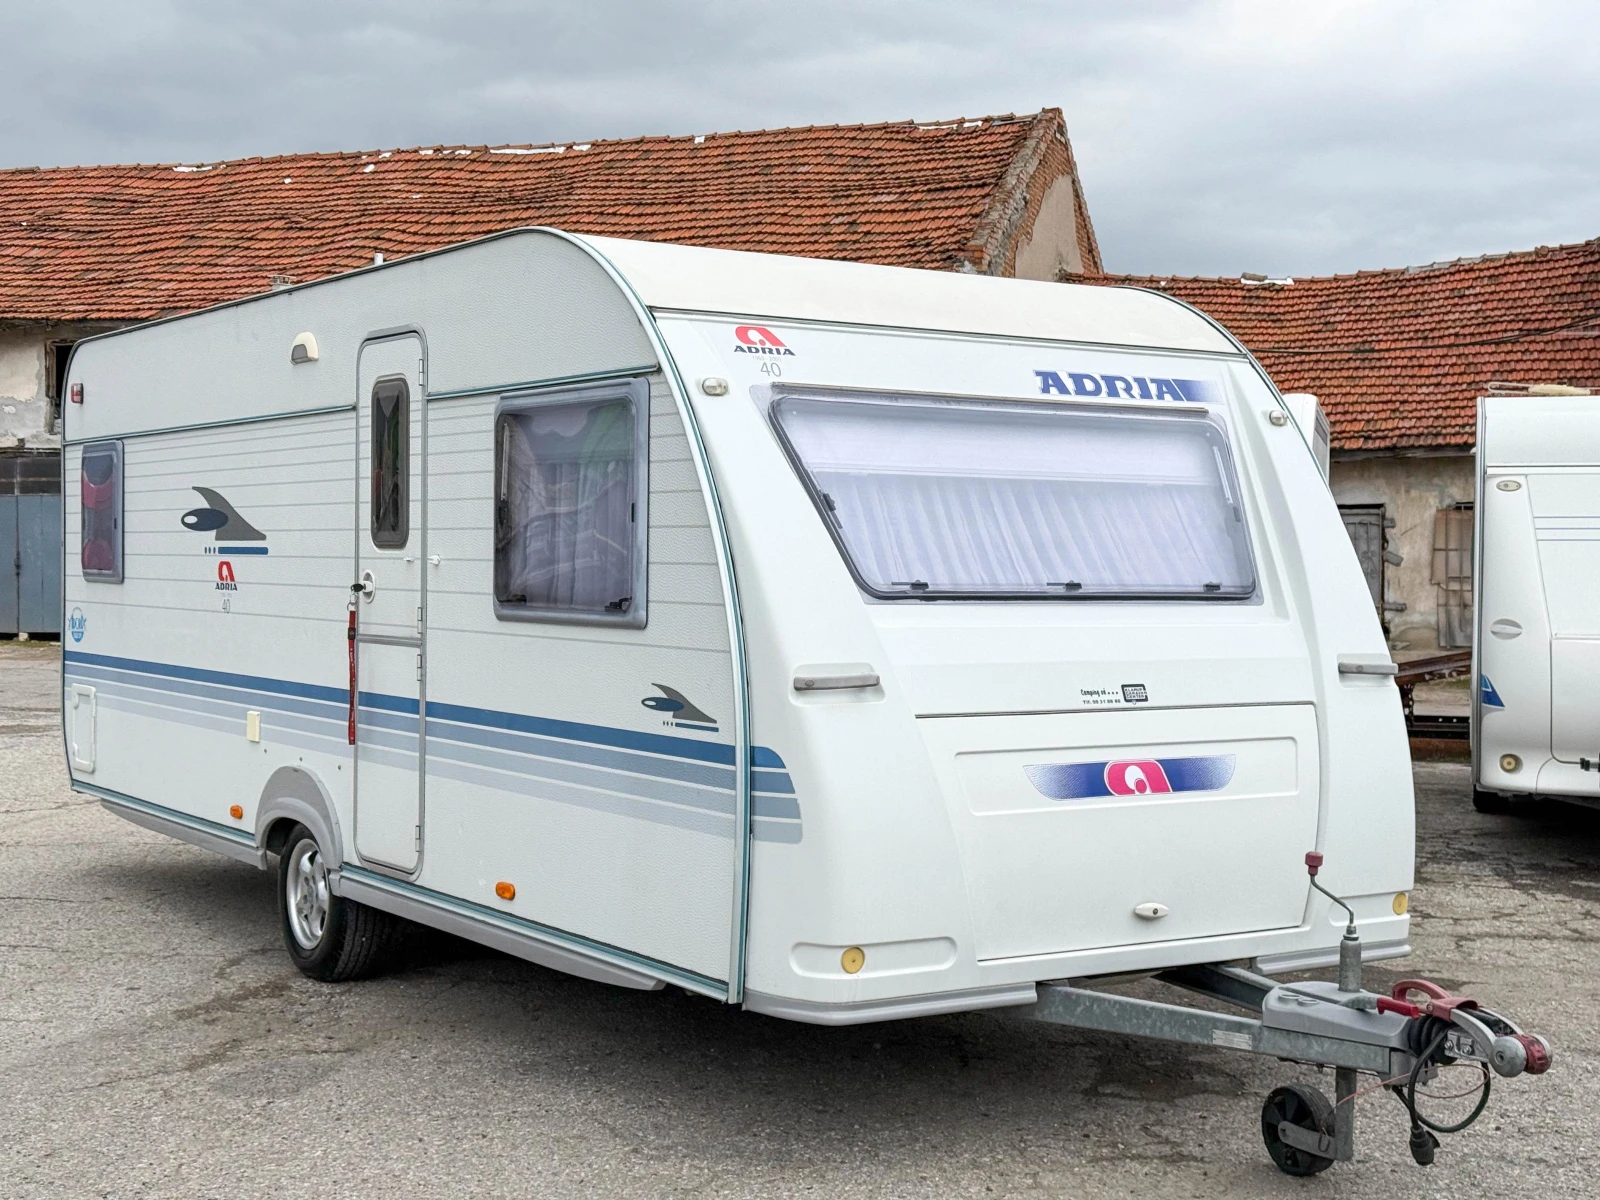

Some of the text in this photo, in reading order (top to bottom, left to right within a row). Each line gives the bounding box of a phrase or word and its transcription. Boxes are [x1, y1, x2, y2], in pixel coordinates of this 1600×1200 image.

[734, 345, 796, 356] ADRIA
[760, 362, 781, 377] 40
[1034, 370, 1188, 401] ADRIA
[215, 582, 238, 591] ADRIA
[222, 599, 231, 614] 40
